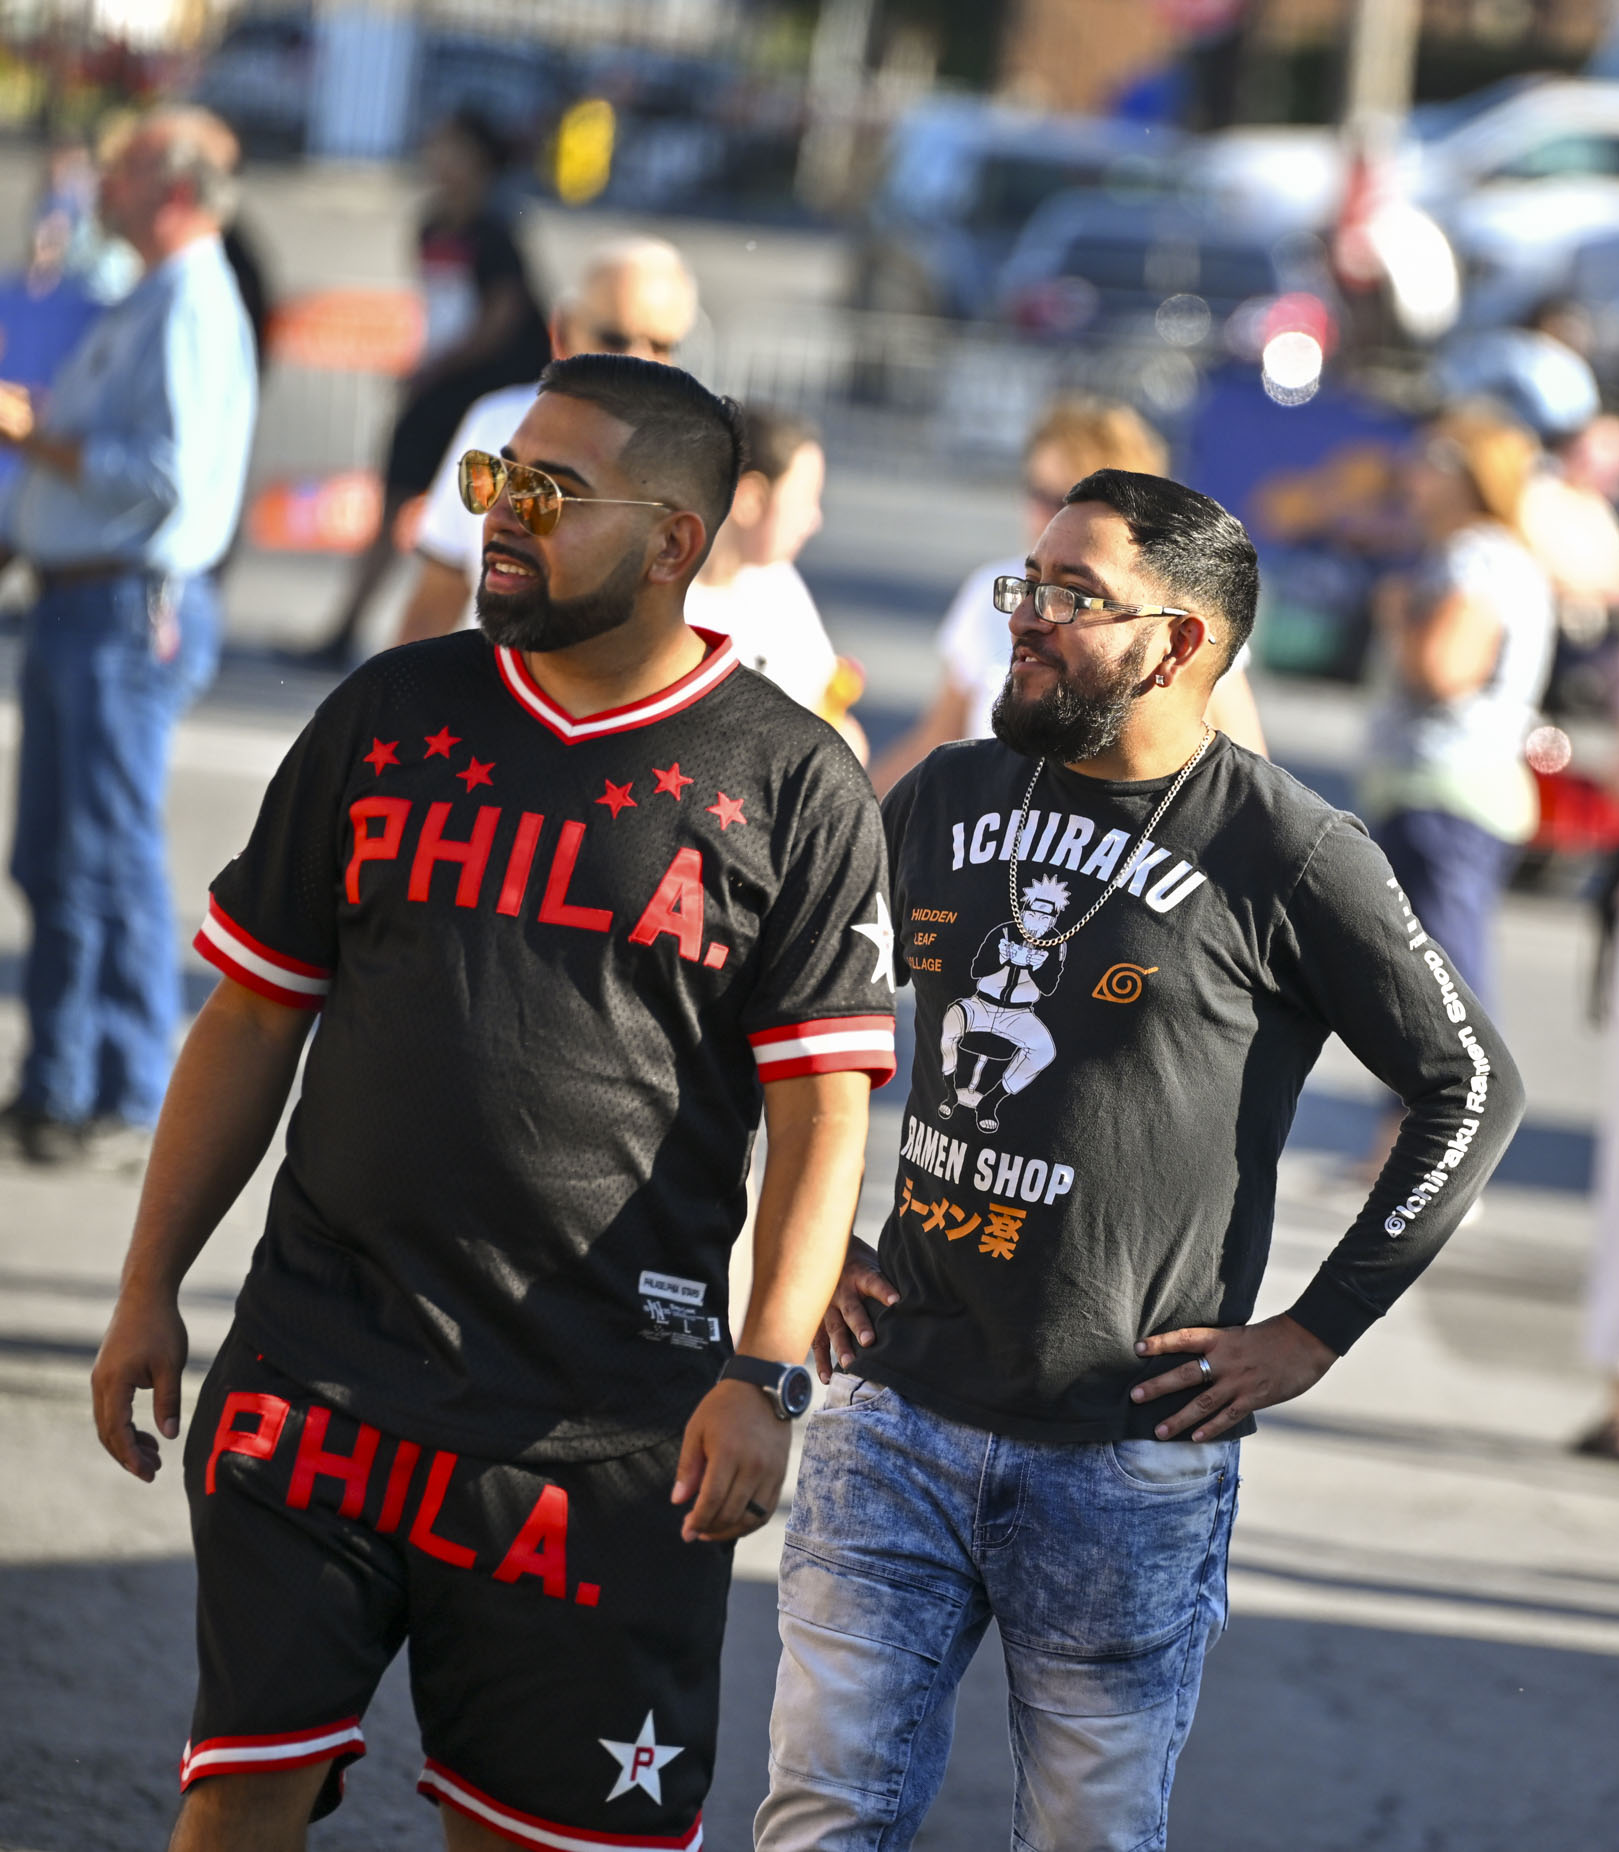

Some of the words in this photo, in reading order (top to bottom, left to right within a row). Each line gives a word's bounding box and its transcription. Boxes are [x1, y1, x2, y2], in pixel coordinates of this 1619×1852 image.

[345, 796, 728, 970] PHILA.
[952, 809, 1207, 913] ICHIRAKU
[911, 908, 958, 924] HIDDEN
[914, 931, 937, 946] LEAF
[1424, 950, 1467, 1024] Shop
[1458, 1026, 1491, 1114] Ramen
[901, 1115, 968, 1184] RAMEN
[973, 1148, 1075, 1206] SHOP
[205, 1390, 600, 1607] PHILA.
[630, 1746, 655, 1781] P
